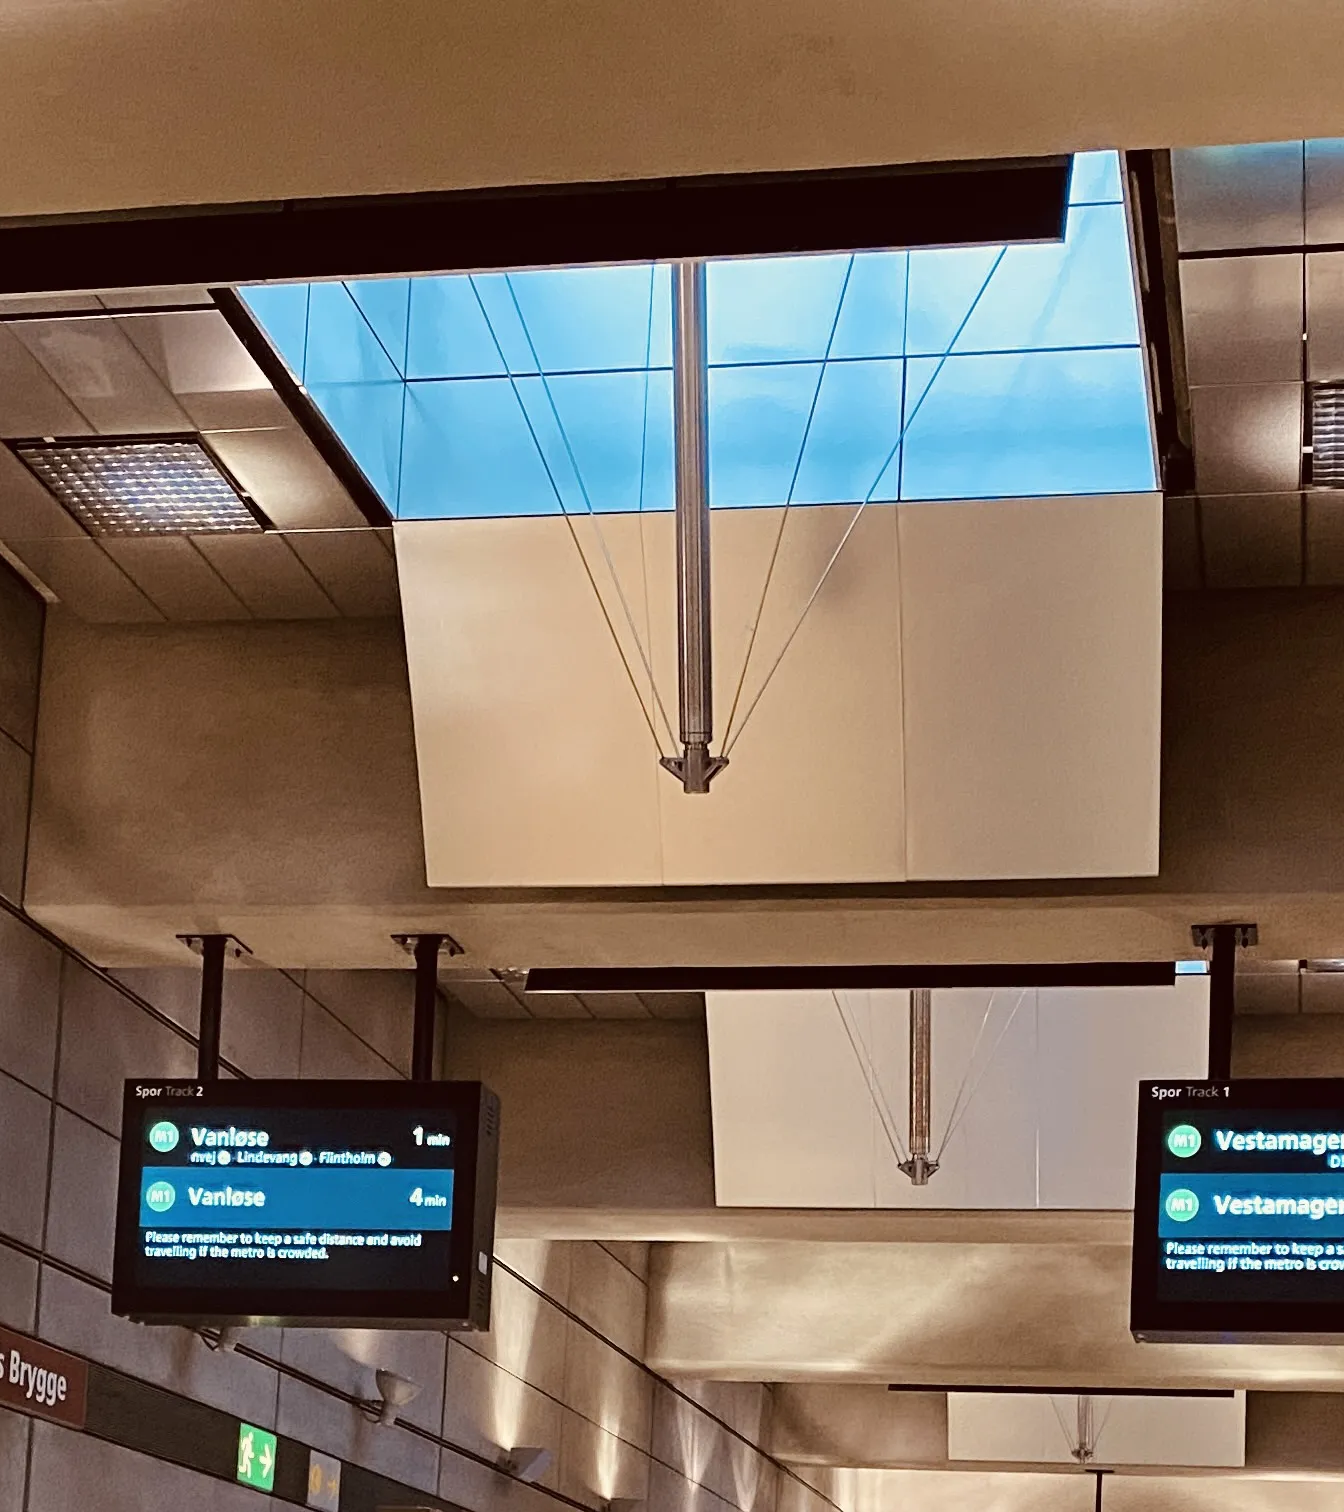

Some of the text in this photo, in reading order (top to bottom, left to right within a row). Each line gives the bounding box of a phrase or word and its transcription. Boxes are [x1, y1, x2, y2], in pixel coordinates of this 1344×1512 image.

[136, 1085, 204, 1099] Spor Track 2
[1151, 1085, 1230, 1100] Spor Track 1
[190, 1126, 269, 1147] Vanløse
[413, 1126, 451, 1146] 1 min
[1173, 1133, 1196, 1148] M1
[236, 1150, 297, 1166] Lindevang
[318, 1151, 376, 1165] Flintholm
[188, 1186, 266, 1207] Vanløse
[409, 1187, 447, 1207] 4 min
[1170, 1197, 1193, 1212] M1
[145, 1231, 422, 1247] Please remember to keep a safe distance and avoid
[144, 1246, 196, 1260] travelling
[199, 1246, 208, 1257] if
[209, 1246, 229, 1258] the
[230, 1247, 264, 1258] metro
[266, 1246, 276, 1258] is
[1166, 1242, 1205, 1255] Please
[1207, 1242, 1273, 1255] remember
[1275, 1243, 1290, 1255] to
[1291, 1242, 1324, 1257] keep
[1325, 1245, 1335, 1255] a
[1165, 1257, 1225, 1272] travelling
[1227, 1257, 1237, 1270] if
[1239, 1257, 1262, 1270] the
[1264, 1258, 1304, 1270] metro
[1306, 1257, 1316, 1270] is
[9, 1350, 67, 1406] Brygge
